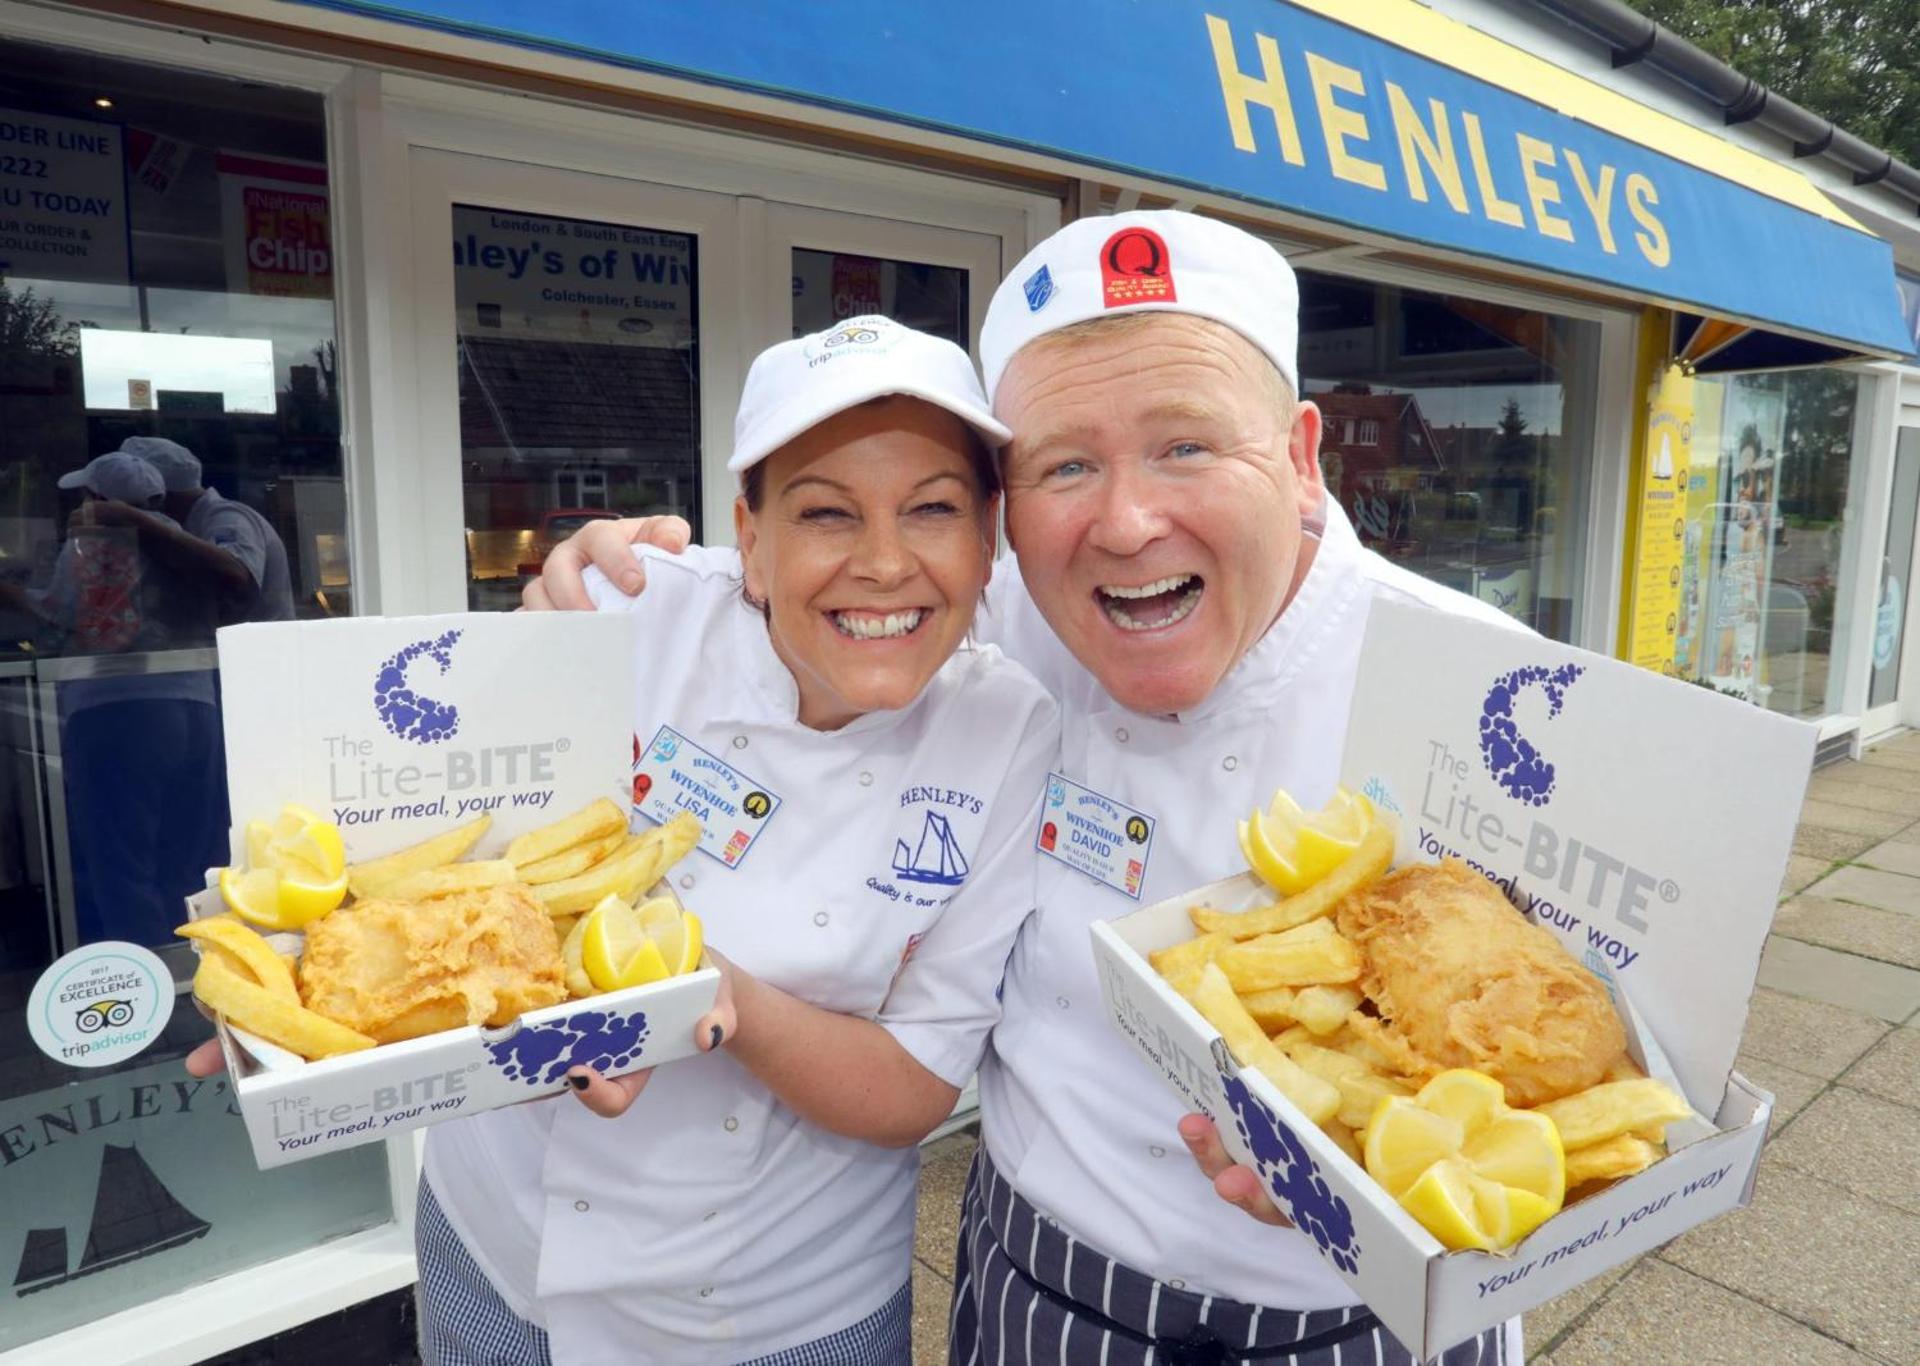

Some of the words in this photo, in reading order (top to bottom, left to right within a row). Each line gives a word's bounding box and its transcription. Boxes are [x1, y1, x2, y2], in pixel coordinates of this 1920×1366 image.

[58, 132, 111, 155] LINE
[1205, 13, 1671, 268] HENLEYS
[0, 156, 48, 178] 222
[31, 191, 110, 216] TODAY
[253, 192, 328, 214] National
[25, 222, 75, 237] ORDER
[491, 215, 549, 234] London
[556, 224, 567, 236] &
[574, 225, 617, 241] South
[622, 231, 654, 246] East
[249, 236, 330, 275] Chip
[580, 249, 618, 280] of
[1109, 233, 1167, 277] Q
[541, 288, 629, 309] Colchester,
[633, 296, 676, 312] Essex
[323, 736, 374, 757] The
[1428, 739, 1469, 780] The
[333, 805, 383, 827] Your
[391, 796, 450, 823] meal,
[456, 792, 507, 815] your
[512, 788, 555, 808] way
[671, 769, 738, 818] WIVENHOE
[674, 791, 710, 821] LISA
[901, 786, 983, 815] HENLEY'S
[1066, 811, 1124, 847] WIVENHOE
[1071, 830, 1111, 858] DAVID
[865, 876, 901, 901] Quality
[903, 890, 913, 902] is
[915, 897, 938, 907] our
[1521, 891, 1581, 934] your
[1587, 925, 1640, 970] way
[60, 977, 143, 1003] EXCELLENCE
[65, 974, 124, 992] CERTIFICATE
[126, 970, 137, 980] of
[62, 1029, 148, 1059] tripadvisor
[1115, 1009, 1137, 1037] Your
[1167, 1065, 1191, 1097] your
[267, 1095, 312, 1116] The
[278, 1132, 323, 1152] Your
[327, 1116, 377, 1140] meal,
[382, 1106, 425, 1128] your
[430, 1095, 467, 1113] way
[1477, 1260, 1537, 1299] Your
[1540, 1220, 1608, 1268] meal,
[1613, 1190, 1677, 1237] your
[1682, 1163, 1733, 1197] way
